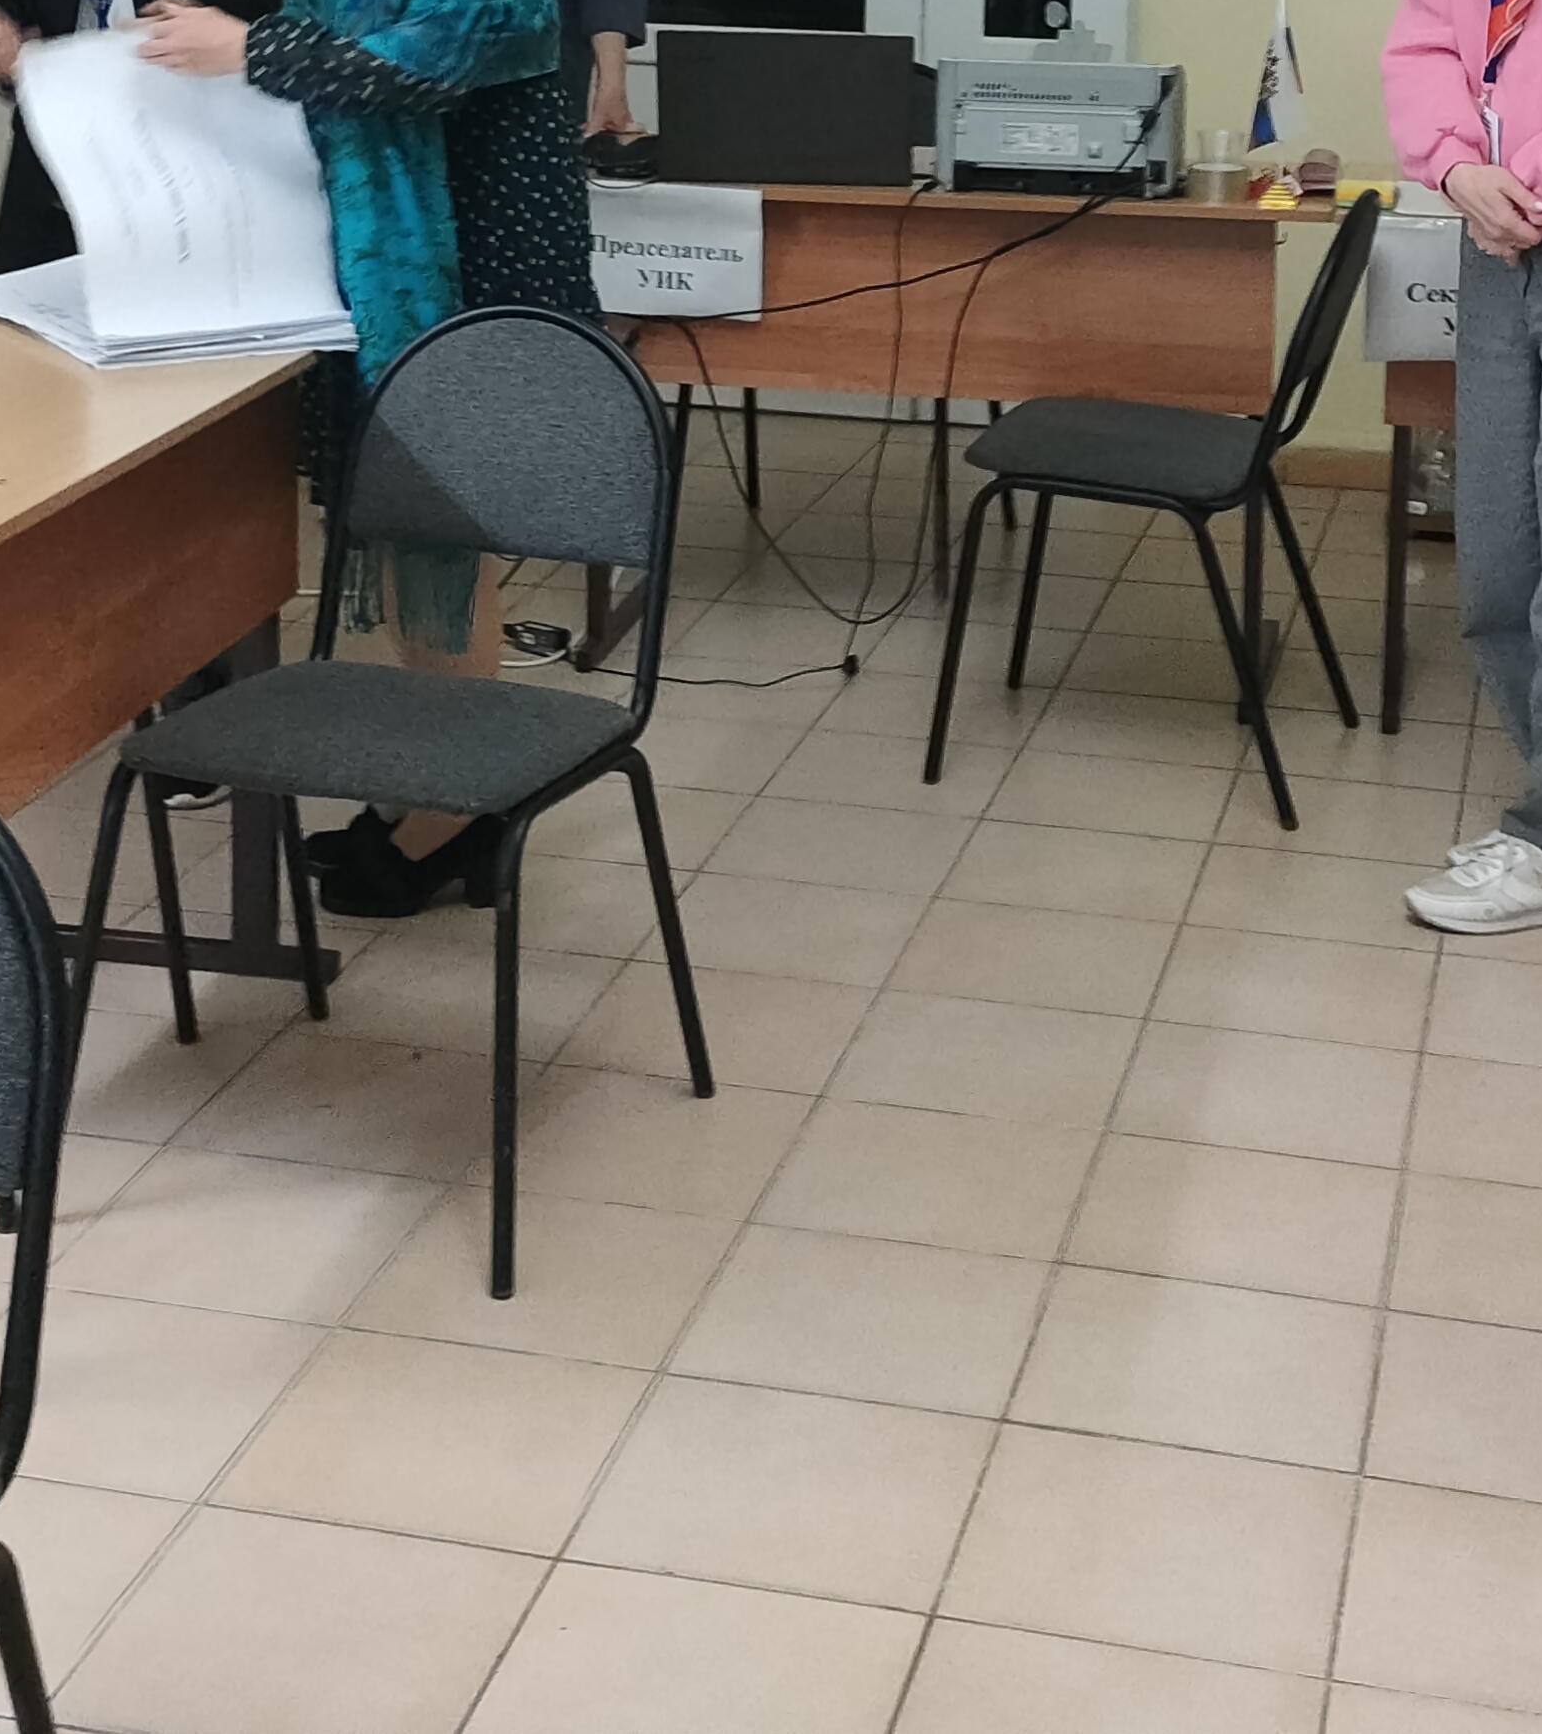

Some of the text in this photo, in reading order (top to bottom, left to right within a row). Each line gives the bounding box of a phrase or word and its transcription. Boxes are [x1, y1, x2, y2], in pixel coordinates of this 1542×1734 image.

[590, 234, 744, 263] Председатель
[636, 268, 694, 292] УИК
[1407, 282, 1459, 303] Сек
